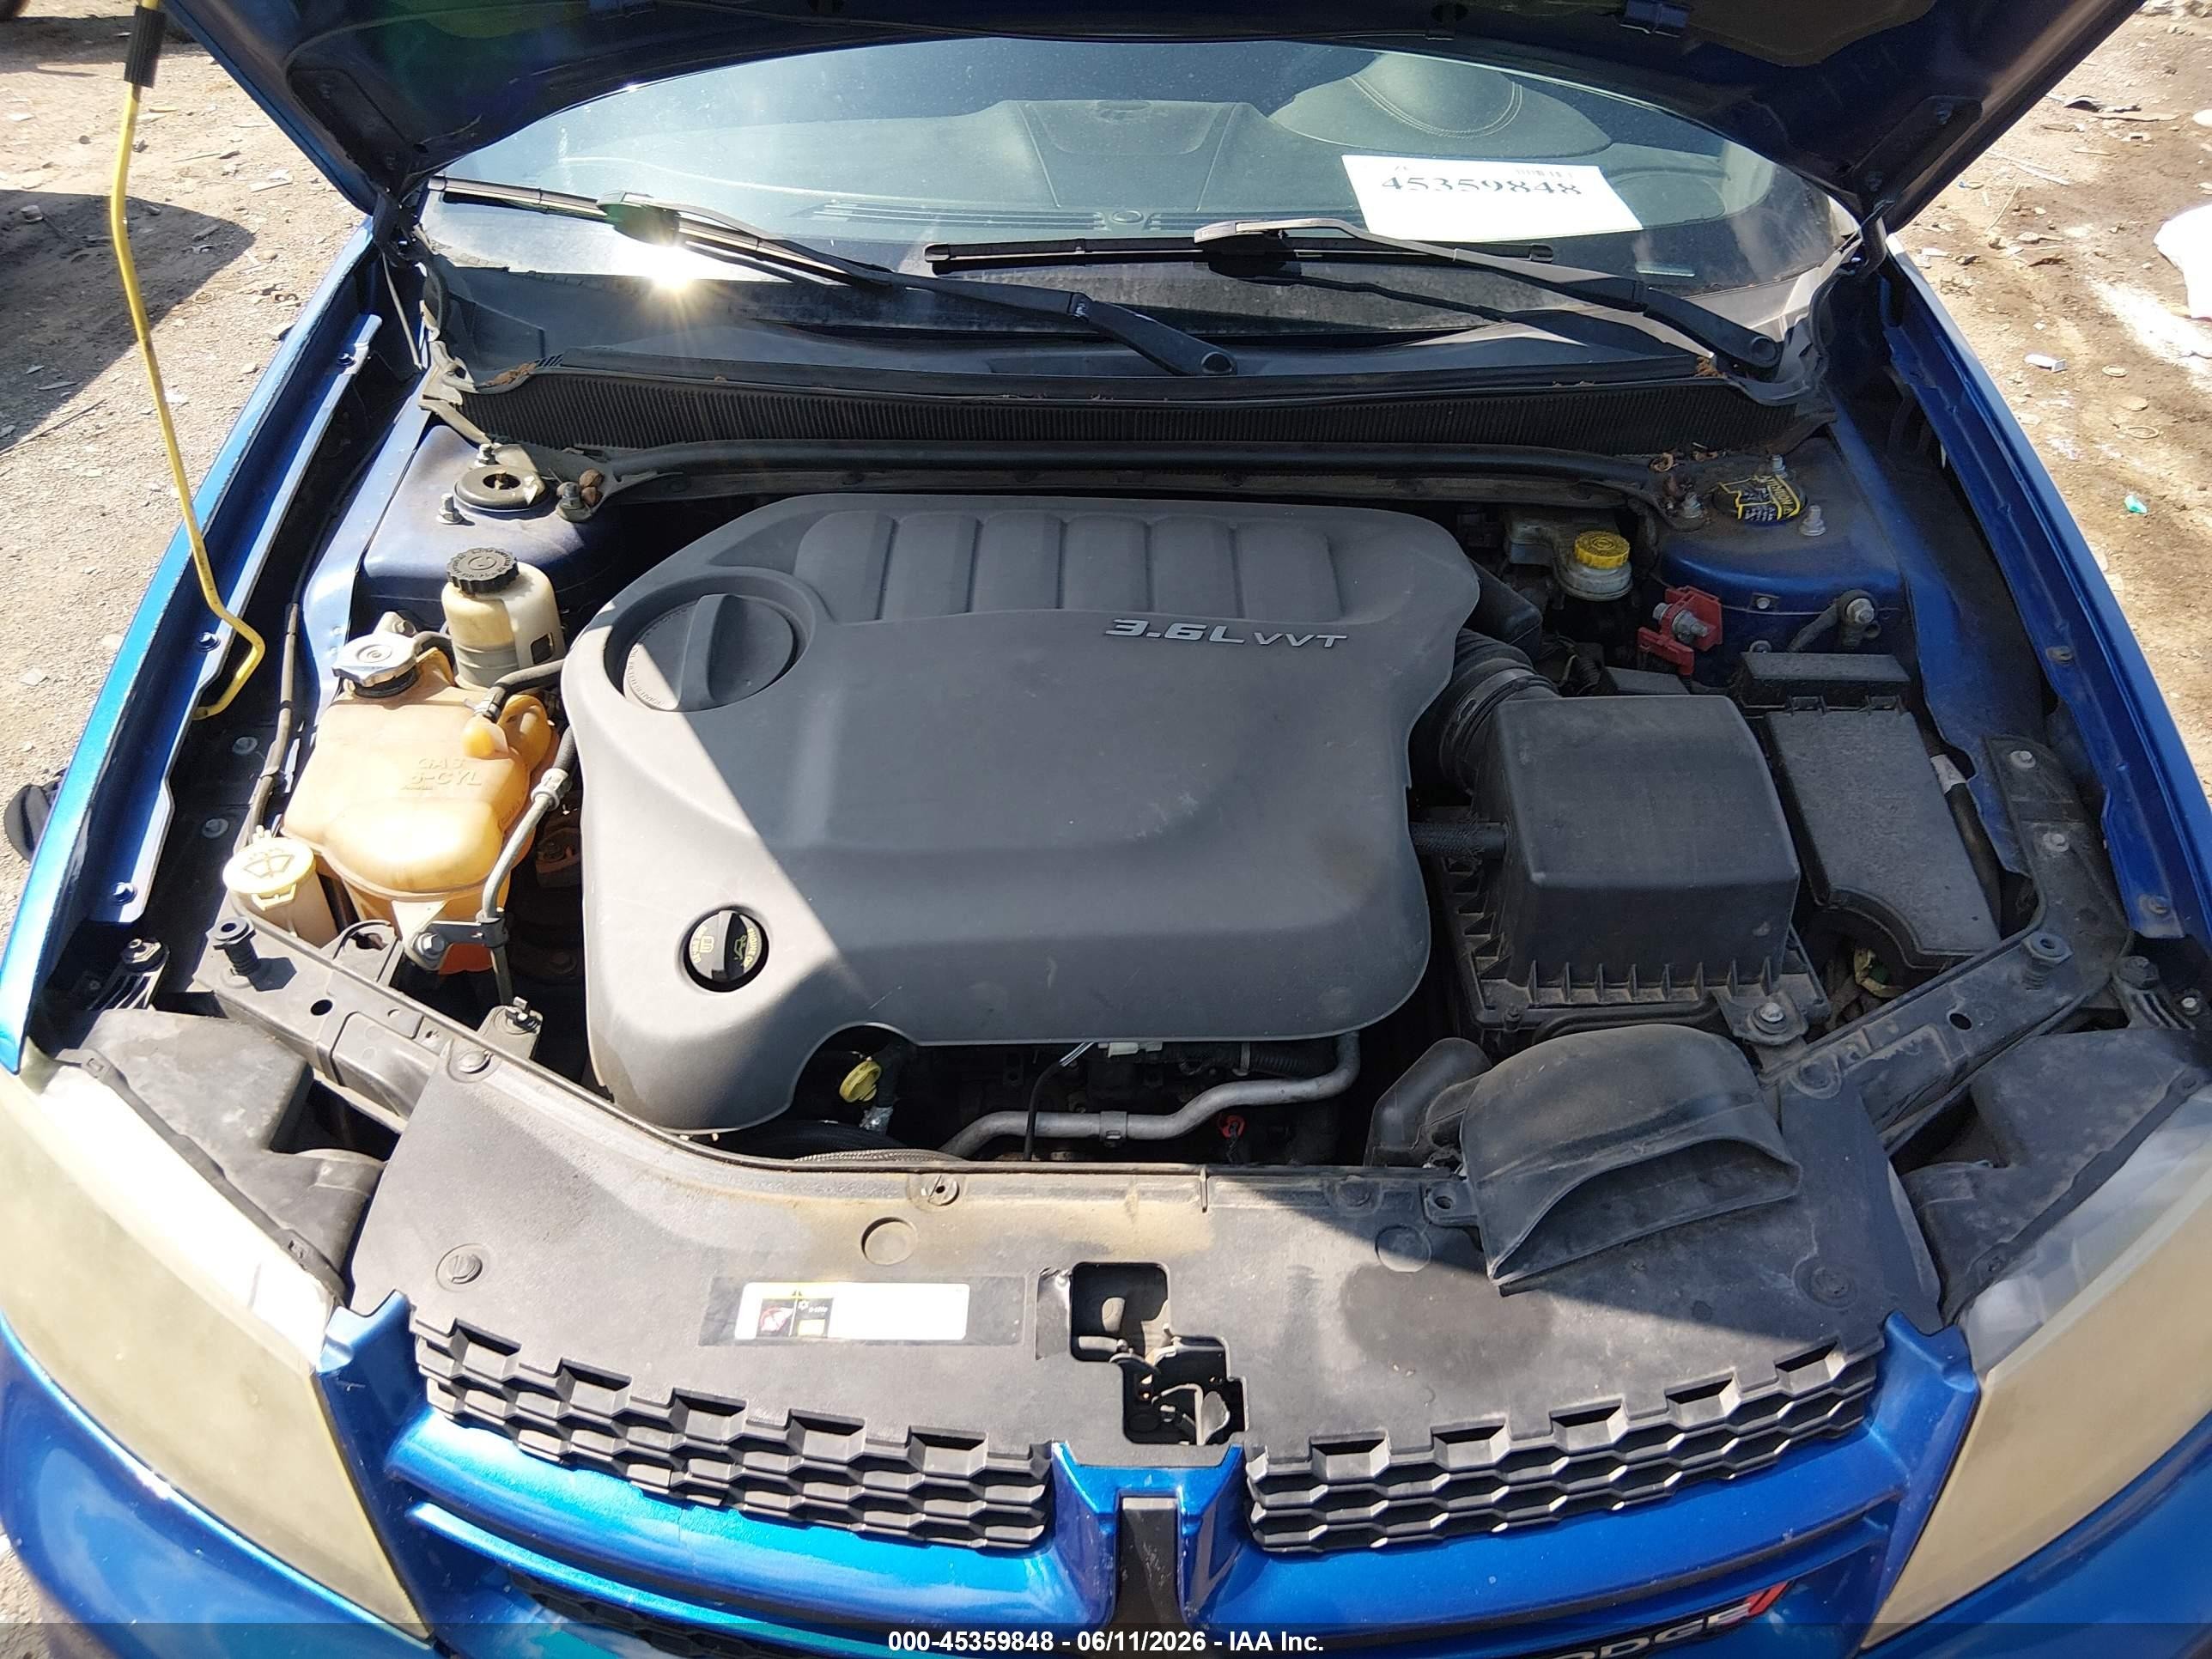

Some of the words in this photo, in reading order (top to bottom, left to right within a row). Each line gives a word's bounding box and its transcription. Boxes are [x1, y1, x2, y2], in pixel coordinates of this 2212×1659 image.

[1381, 175, 1583, 195] 45359848
[1105, 619, 1245, 643] 3.6L
[1253, 632, 1347, 648] VVT
